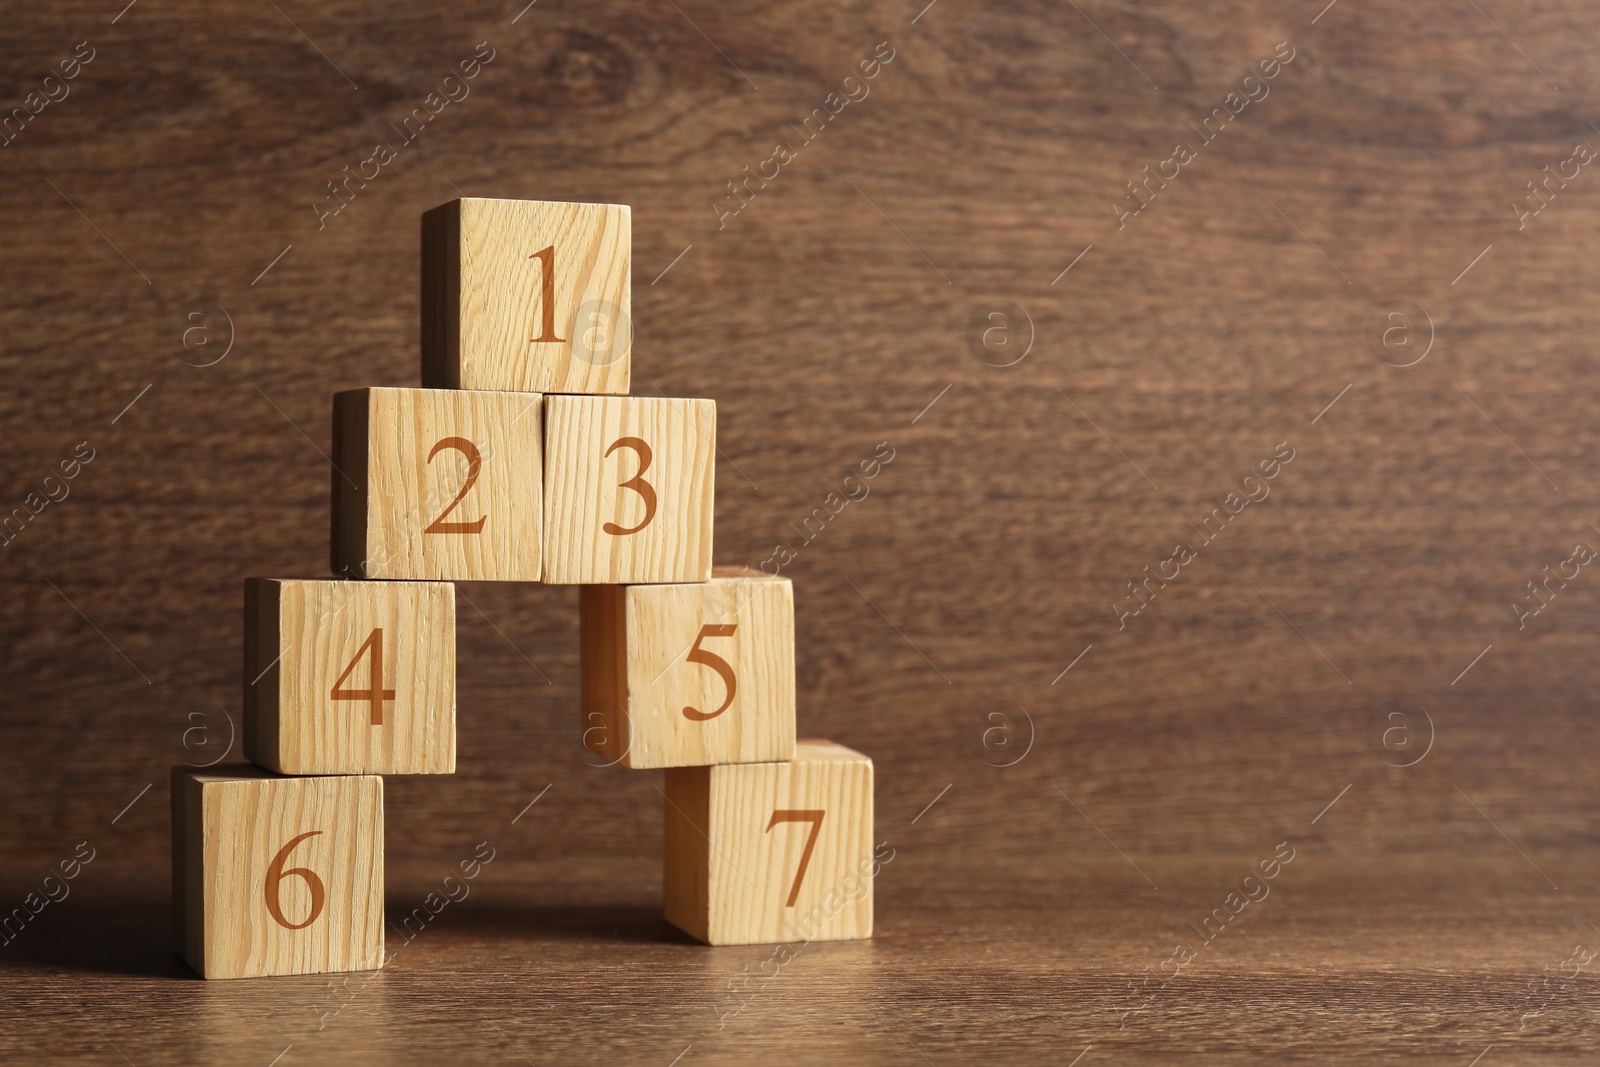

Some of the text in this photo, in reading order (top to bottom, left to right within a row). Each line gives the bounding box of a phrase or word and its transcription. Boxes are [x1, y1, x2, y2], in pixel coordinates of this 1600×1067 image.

[529, 246, 567, 343] 1
[424, 437, 487, 534] 2
[603, 437, 657, 536] 3
[330, 628, 395, 726] 4
[683, 624, 738, 722] 5
[264, 831, 324, 930] 6
[766, 809, 826, 907] 7
